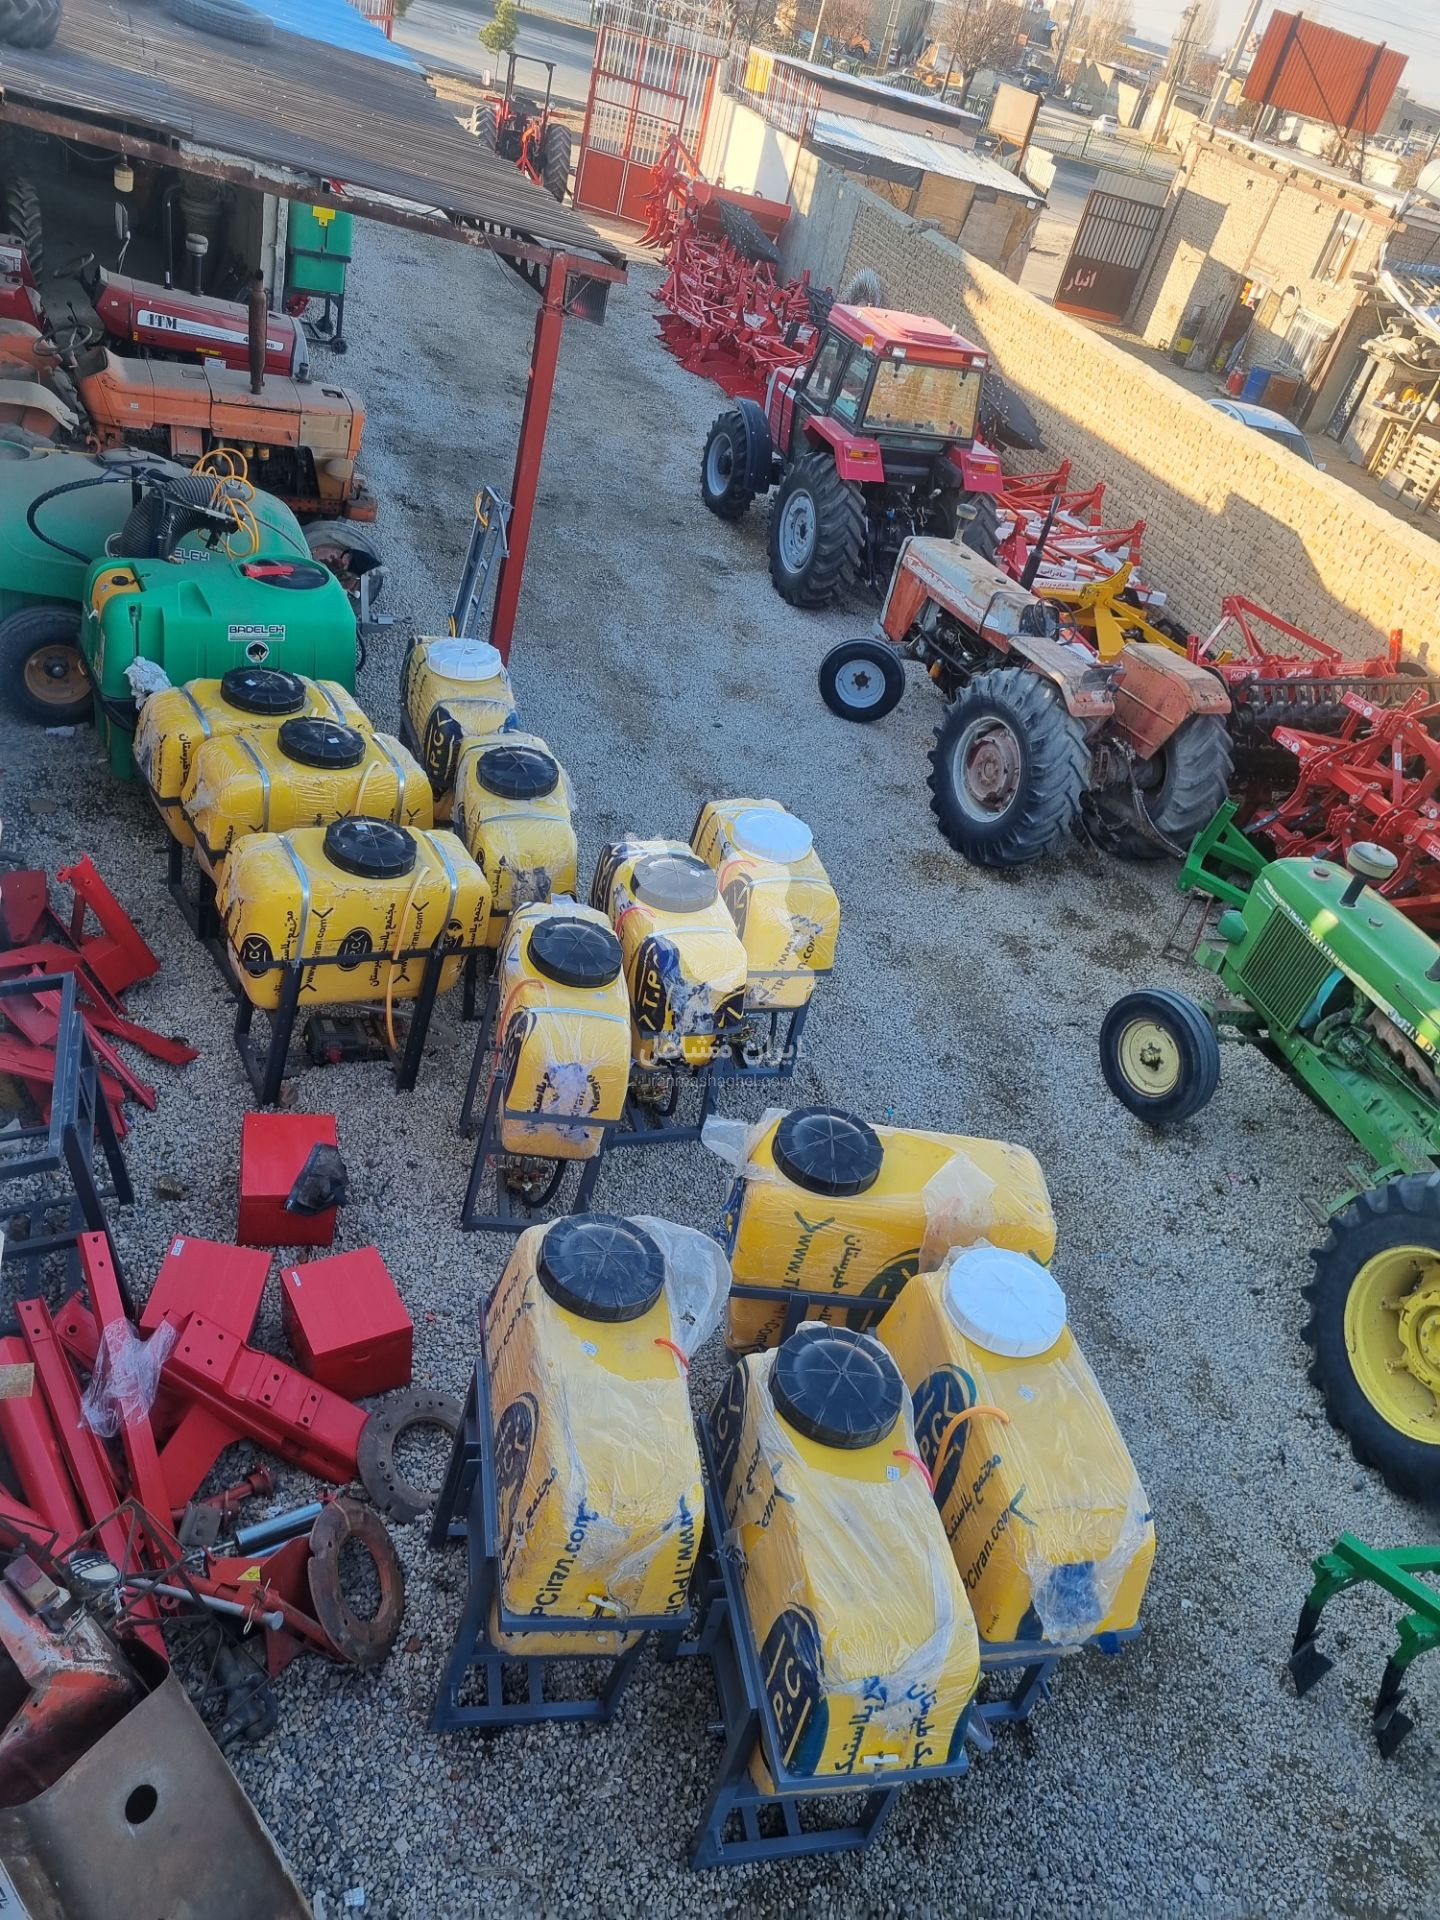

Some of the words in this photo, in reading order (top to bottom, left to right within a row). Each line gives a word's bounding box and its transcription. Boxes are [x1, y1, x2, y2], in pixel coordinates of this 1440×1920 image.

[1063, 268, 1097, 292] انبار
[149, 313, 177, 330] ITM
[175, 547, 210, 562] ELEH
[229, 625, 285, 634] BADELEH
[1387, 1008, 1422, 1041] JOHN
[1423, 1040, 1440, 1064] DE
[963, 1506, 1011, 1592] PCiran.com
[530, 1508, 594, 1618] PCiran.com
